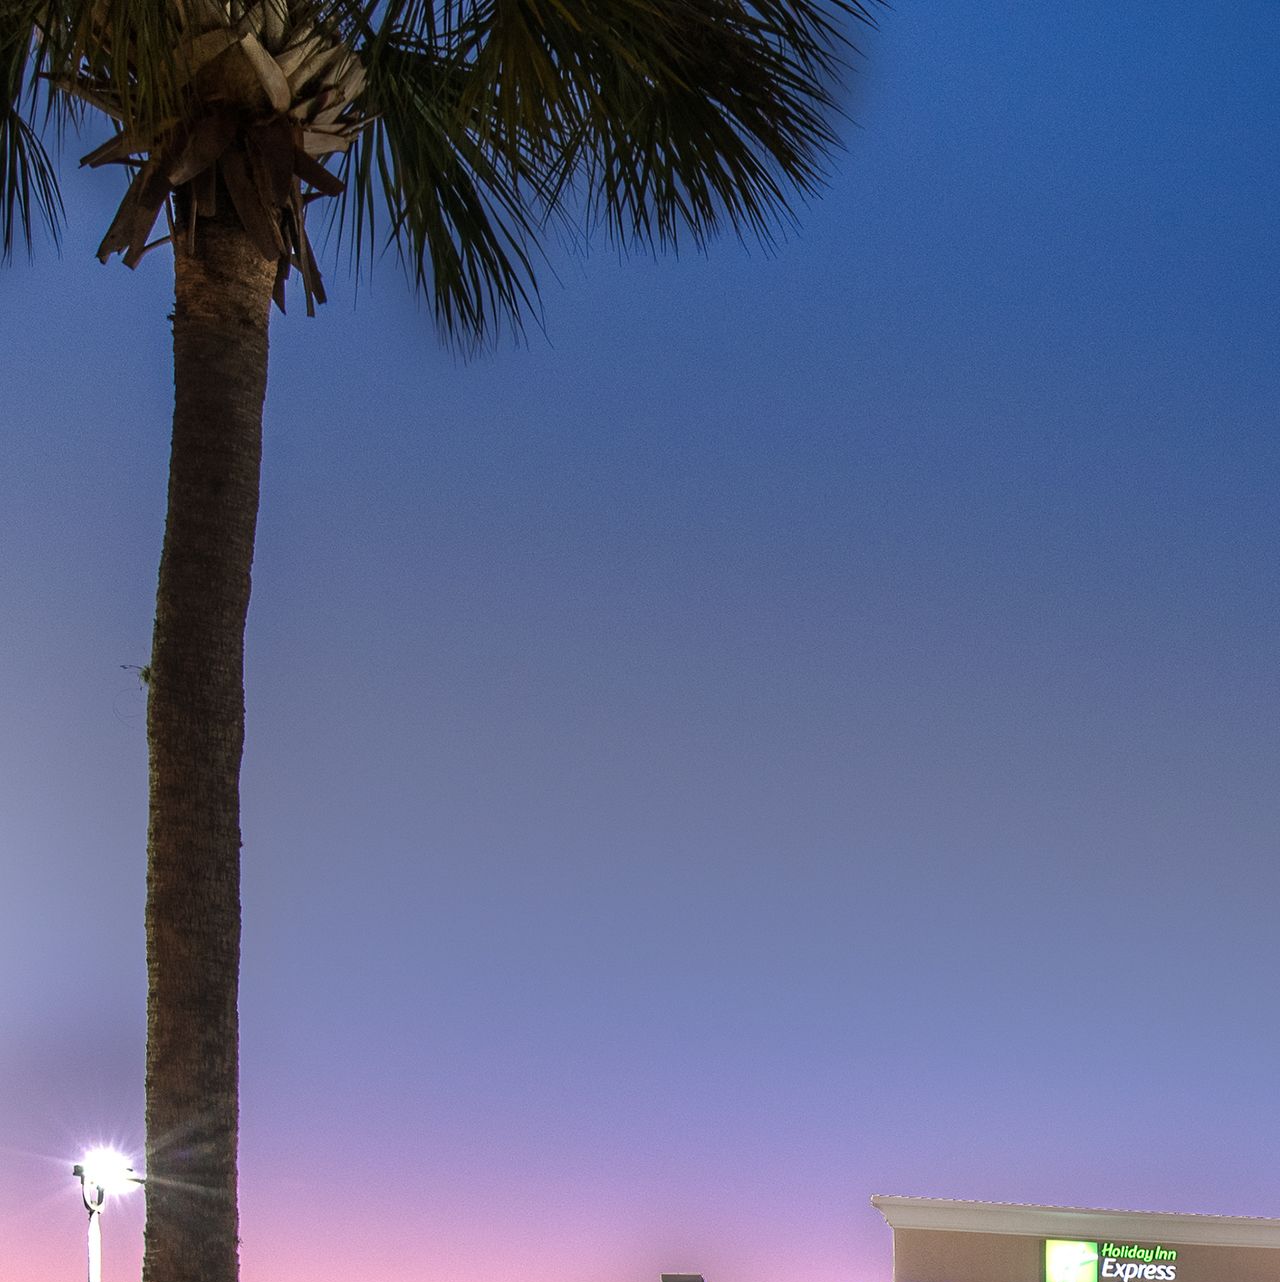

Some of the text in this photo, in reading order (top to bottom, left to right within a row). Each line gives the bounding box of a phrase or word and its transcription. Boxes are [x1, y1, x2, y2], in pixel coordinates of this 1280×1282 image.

[1101, 1242, 1177, 1262] Holiday Inn
[1101, 1257, 1177, 1282] Express
